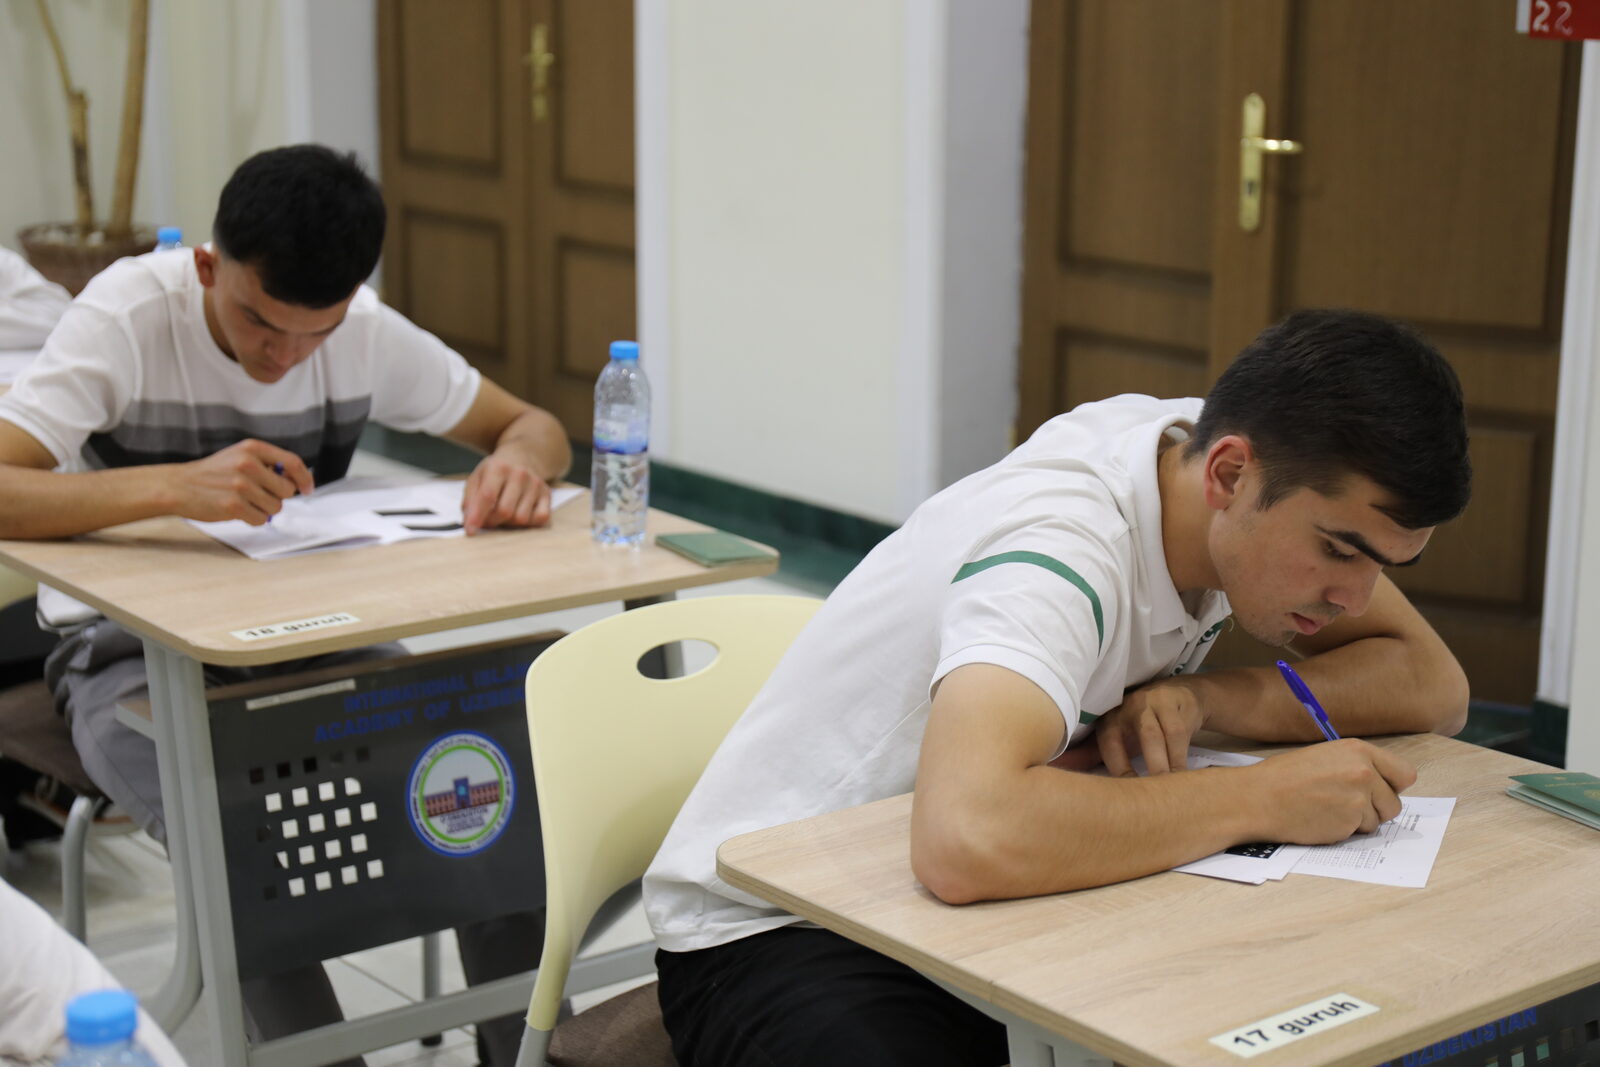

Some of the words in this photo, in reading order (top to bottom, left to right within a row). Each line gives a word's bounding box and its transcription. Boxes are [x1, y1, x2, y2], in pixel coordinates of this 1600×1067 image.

[1532, 0, 1573, 36] 22
[343, 674, 468, 713] INTERNATIONAL
[313, 708, 415, 743] ACADEMY
[423, 700, 451, 721] OF
[1233, 1028, 1270, 1048] 17
[1277, 1000, 1361, 1036] guruh
